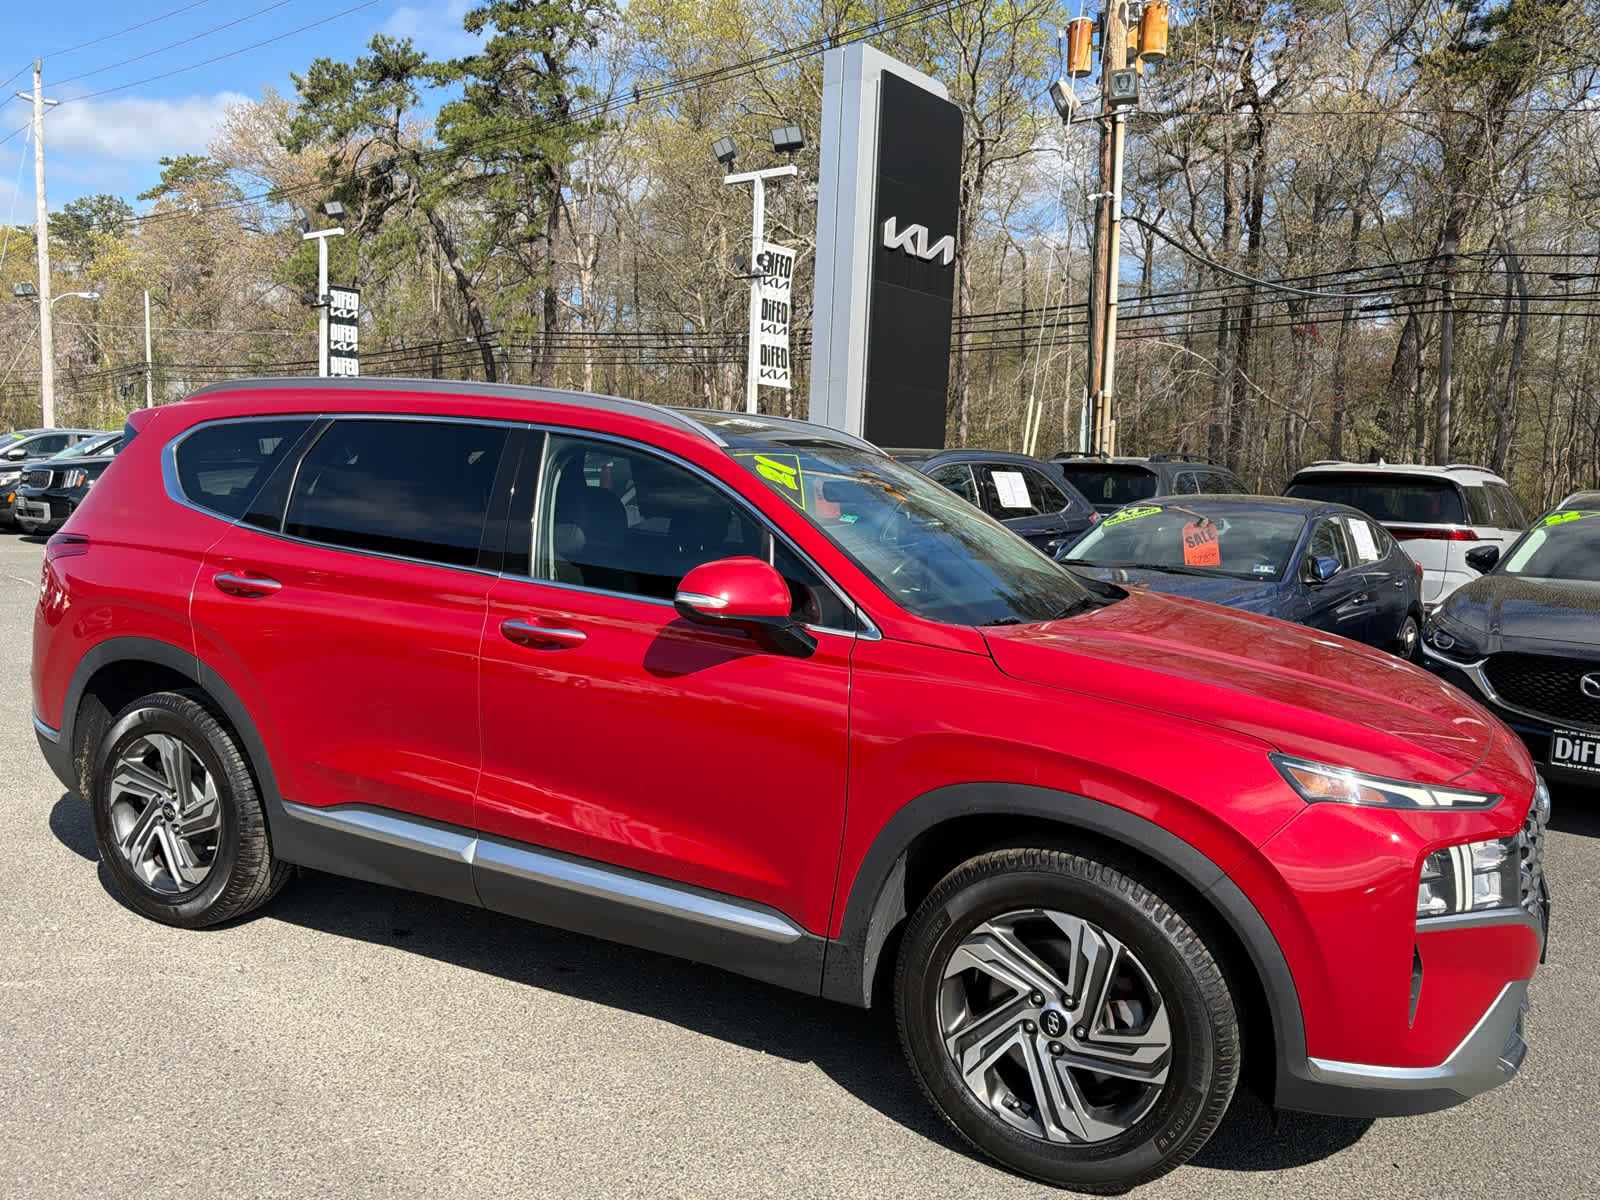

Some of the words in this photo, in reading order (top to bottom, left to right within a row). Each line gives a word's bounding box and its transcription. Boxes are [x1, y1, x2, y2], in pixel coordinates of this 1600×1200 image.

[884, 216, 954, 265] KIA
[761, 322, 787, 335] KIA
[760, 368, 788, 380] KIA
[1185, 527, 1216, 549] SALE
